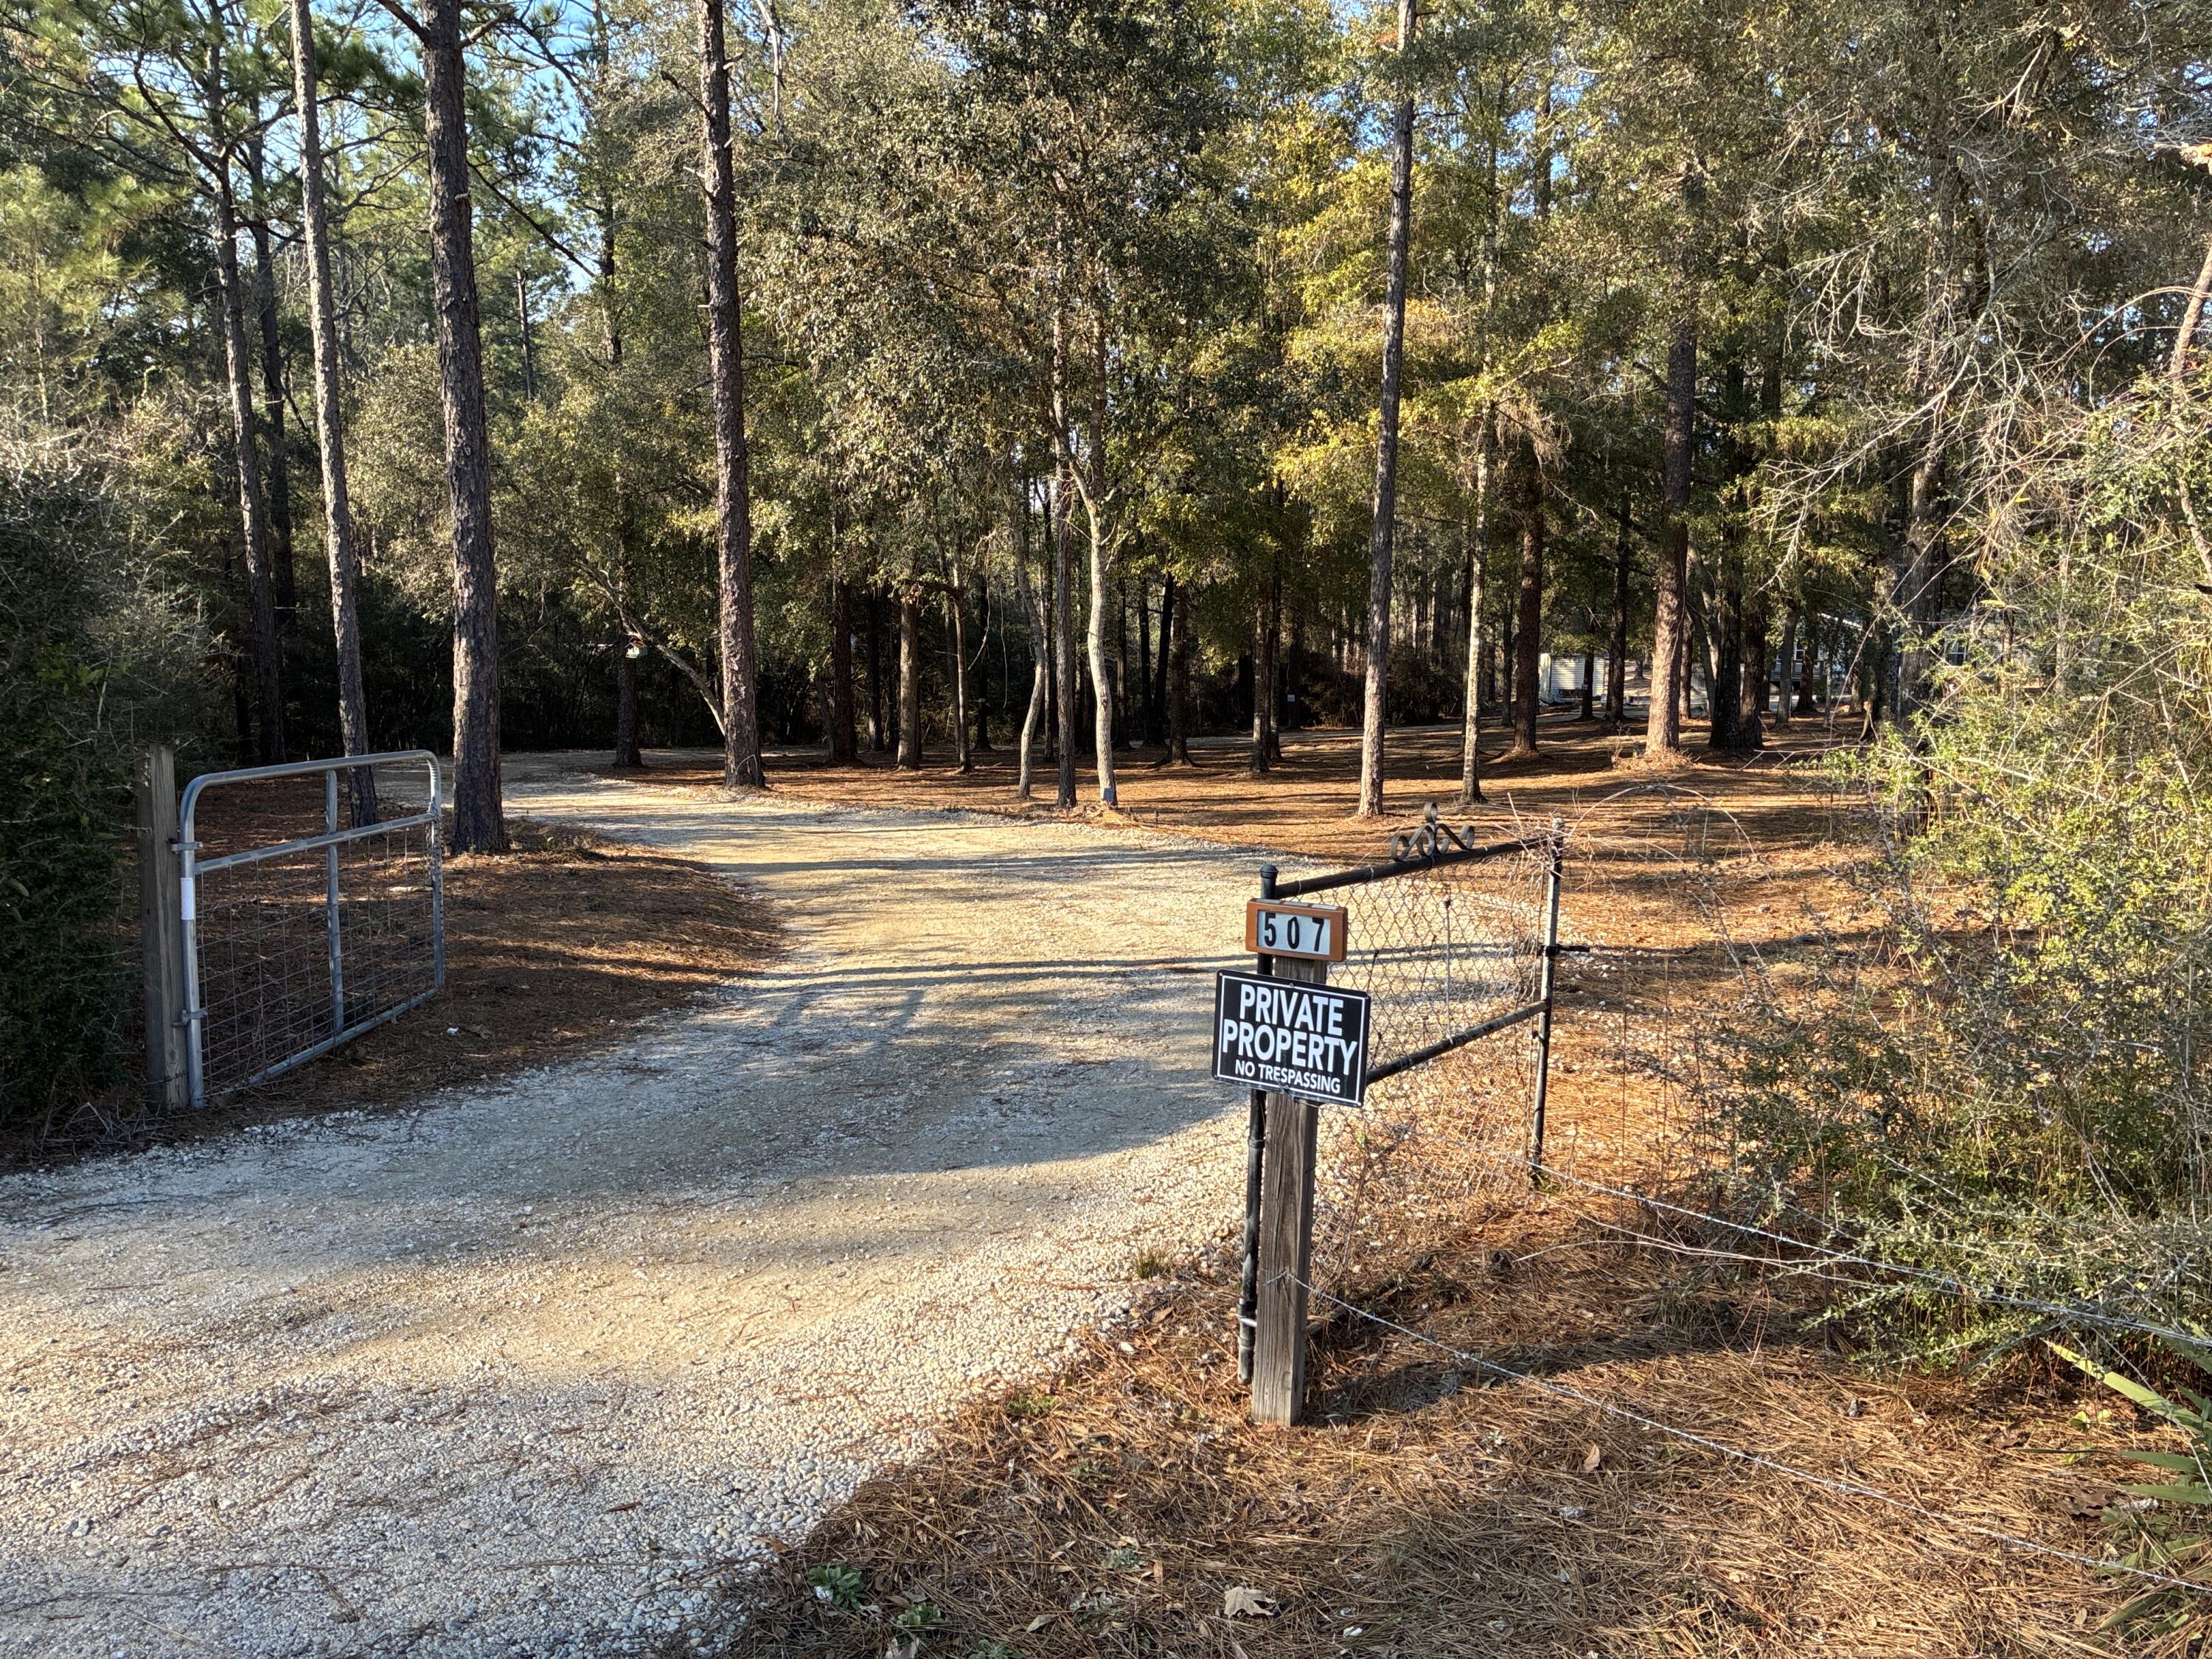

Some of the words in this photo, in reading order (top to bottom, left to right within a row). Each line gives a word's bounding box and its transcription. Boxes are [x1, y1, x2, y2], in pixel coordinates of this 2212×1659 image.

[1264, 912, 1324, 952] 507
[1239, 984, 1344, 1036] PRIVATE
[1222, 1018, 1358, 1076] PROPERTY
[1234, 1059, 1256, 1077] NO
[1258, 1063, 1341, 1094] TRESPASSING
